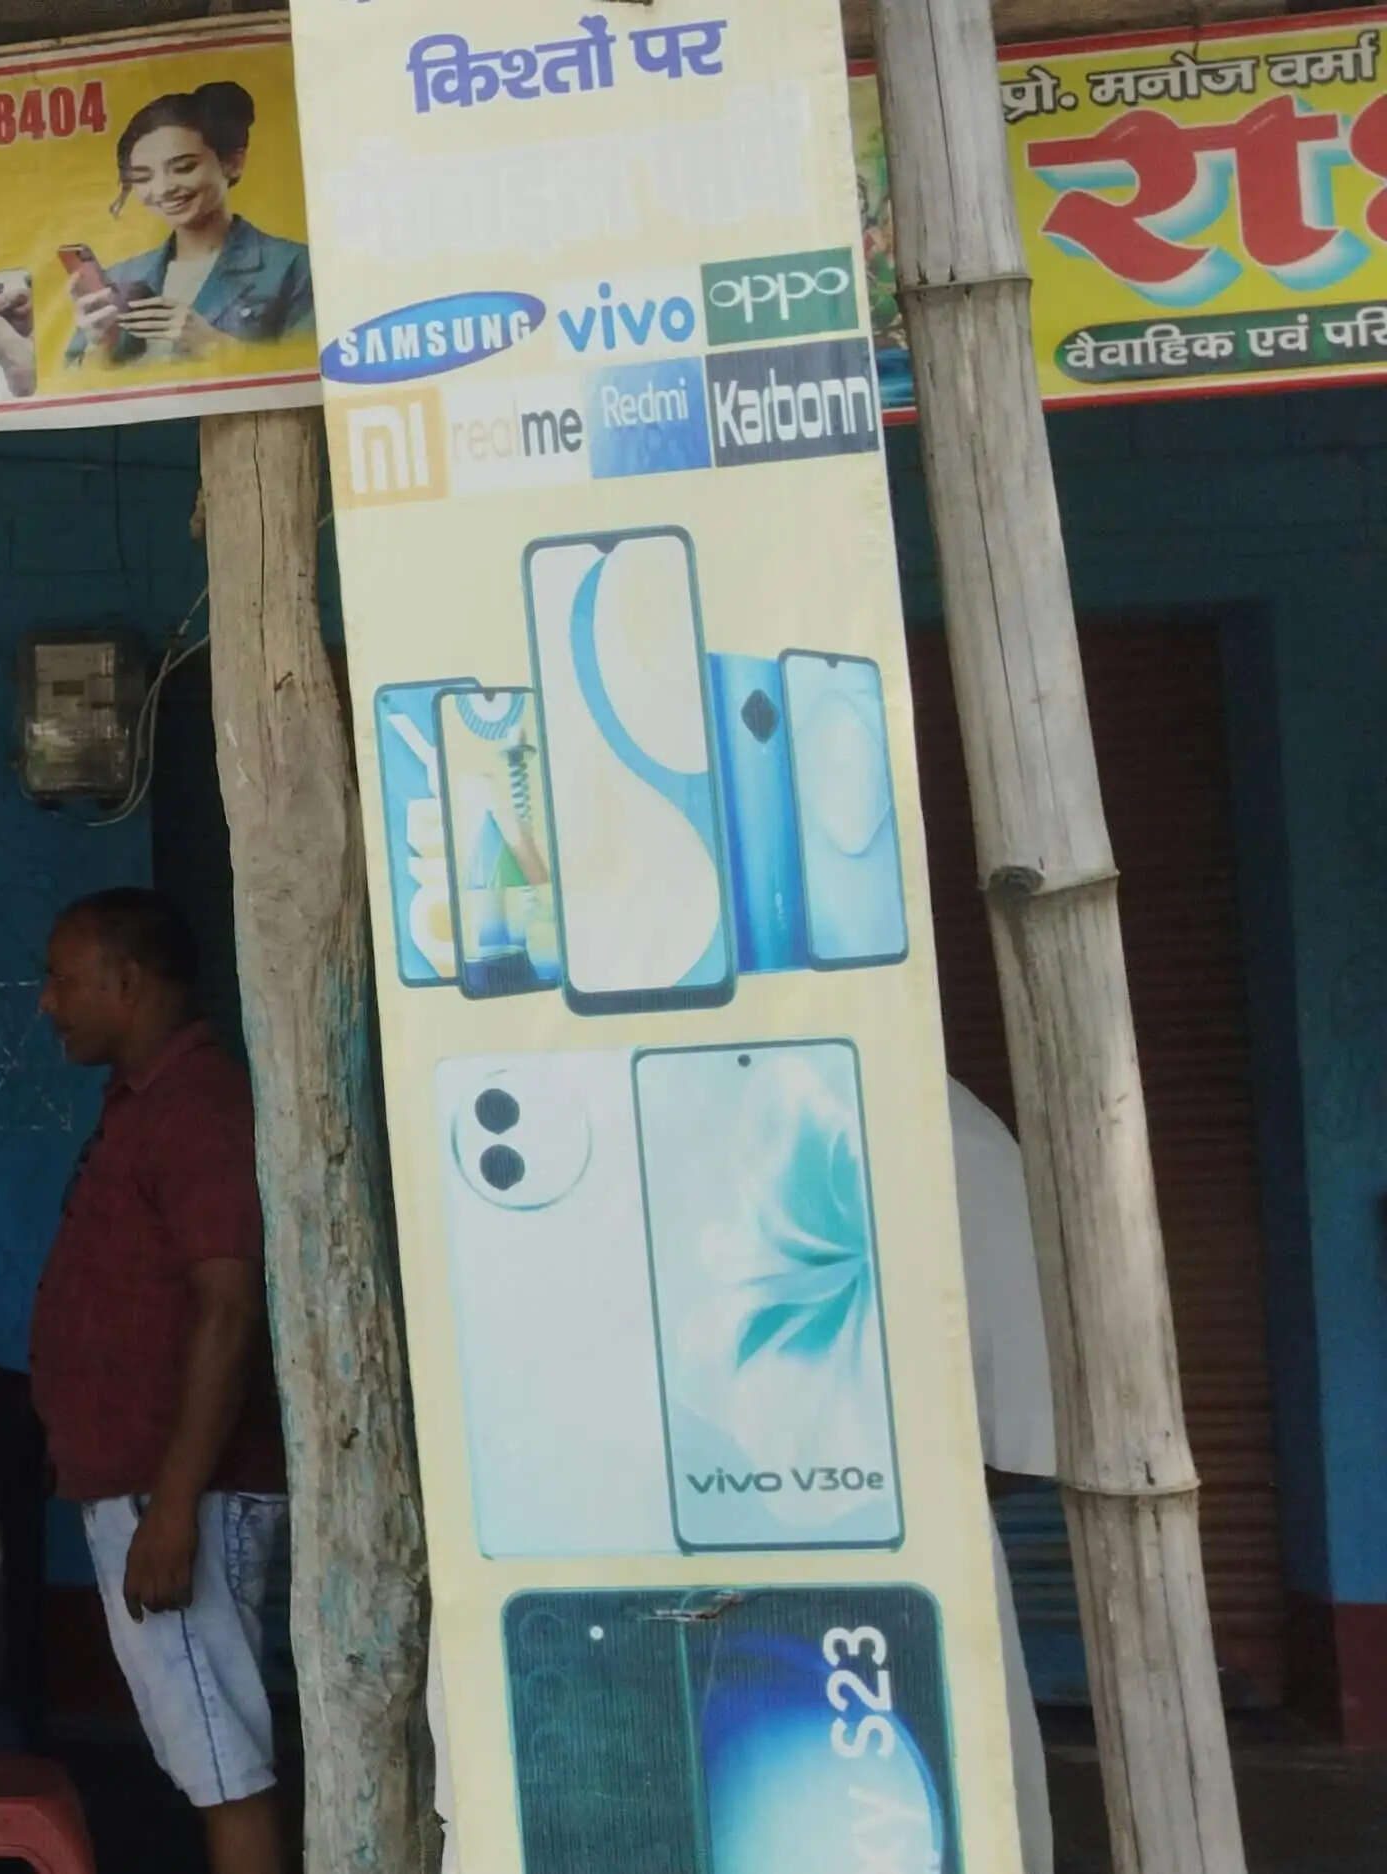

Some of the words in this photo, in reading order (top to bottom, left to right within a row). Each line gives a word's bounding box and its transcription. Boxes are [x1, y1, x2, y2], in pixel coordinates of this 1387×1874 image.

[406, 15, 616, 114] किश्तों
[629, 20, 727, 79] पर
[1000, 66, 1078, 124] प्रो.
[1088, 50, 1259, 106] मनोज
[1267, 32, 1378, 88] वर्मा
[340, 312, 532, 367] SAMSUNG
[558, 283, 695, 352] vivo
[1064, 324, 1233, 369] वैवाहिक
[1246, 314, 1308, 358] एवं
[450, 403, 583, 462] realme
[601, 379, 688, 428] Redmi
[714, 369, 876, 448] Karbonn
[686, 1466, 782, 1494] vivo
[792, 1466, 885, 1492] V30e
[823, 1626, 896, 1759] S23
